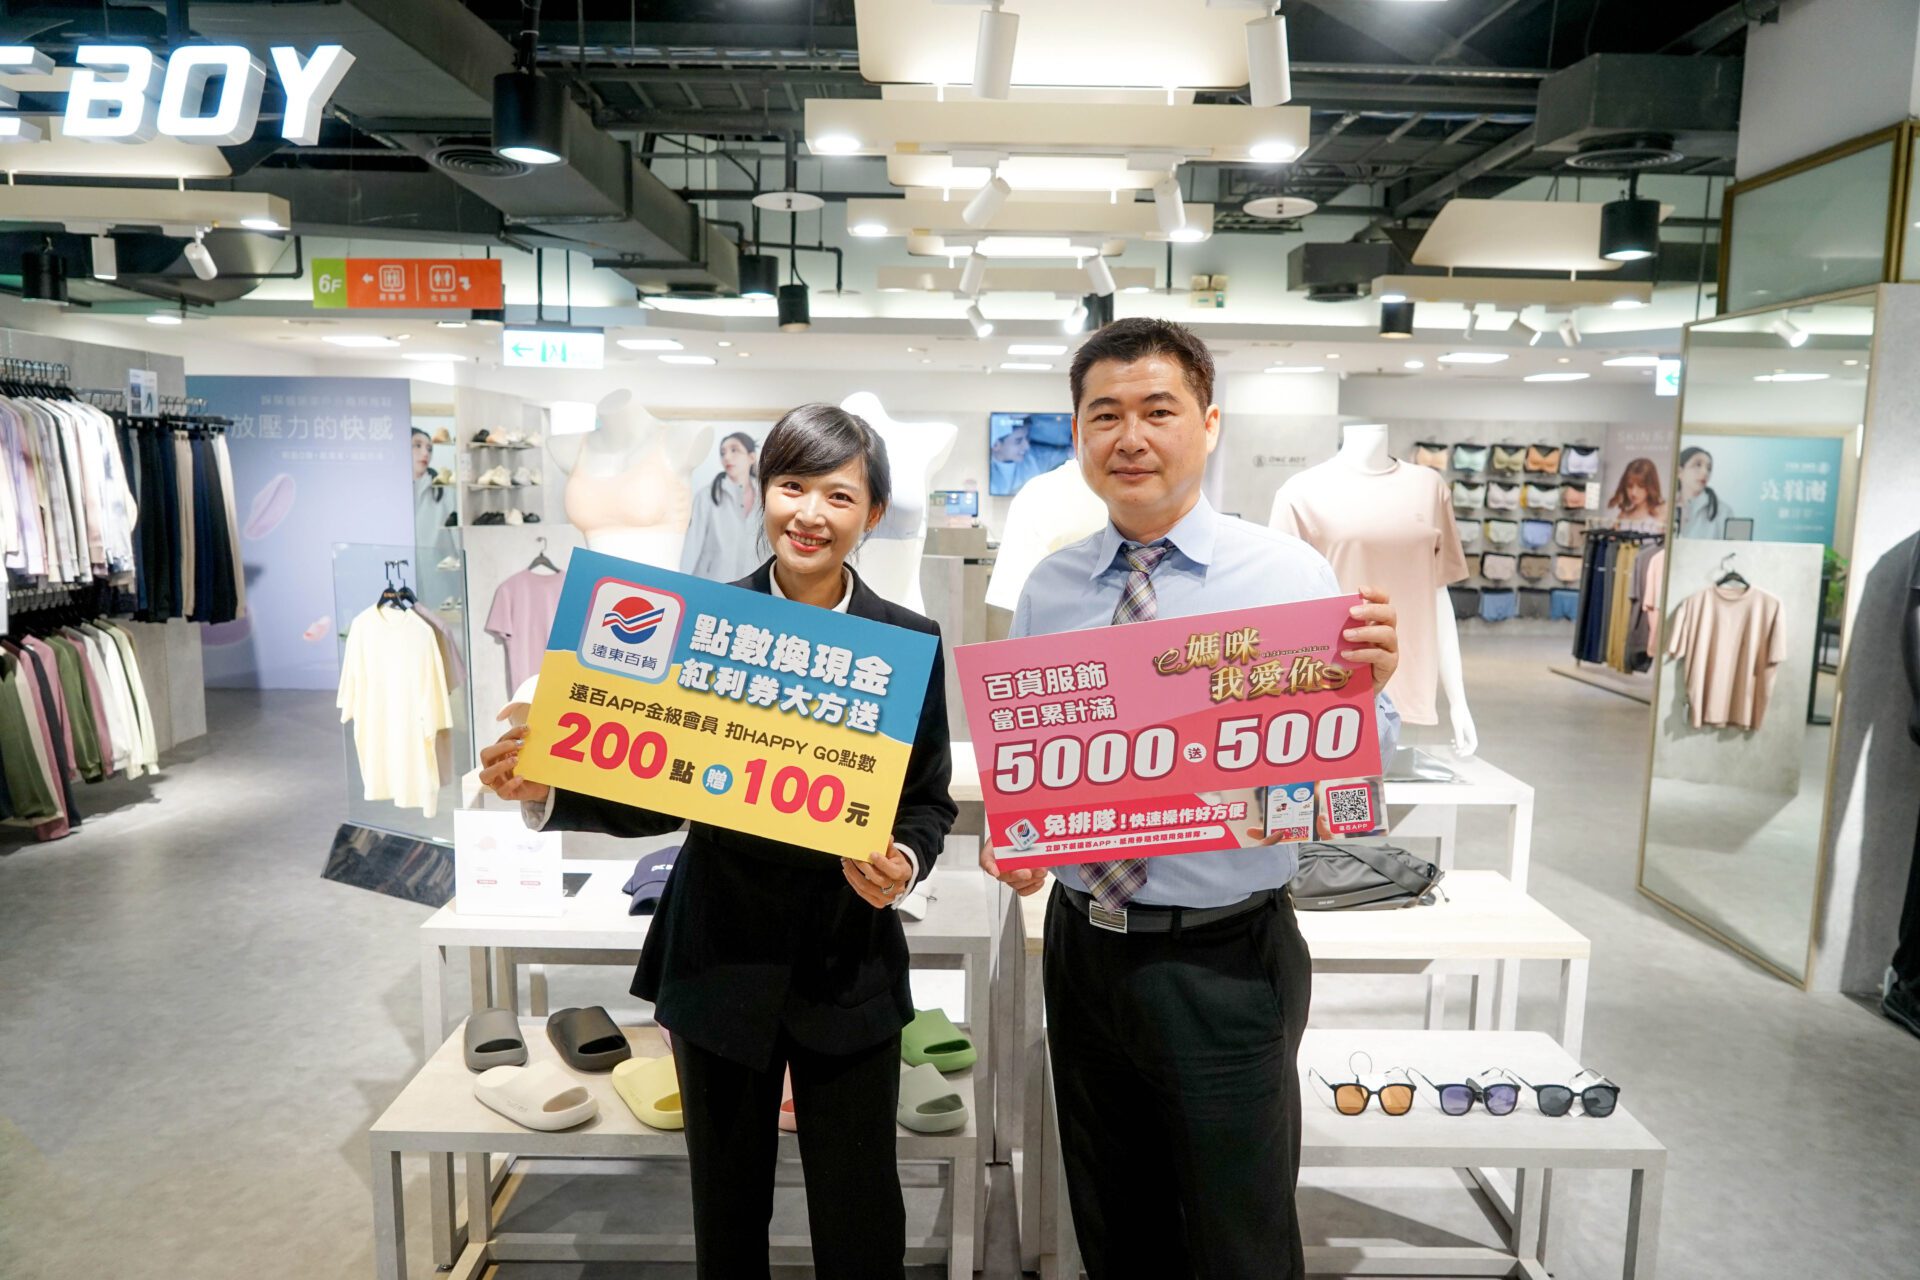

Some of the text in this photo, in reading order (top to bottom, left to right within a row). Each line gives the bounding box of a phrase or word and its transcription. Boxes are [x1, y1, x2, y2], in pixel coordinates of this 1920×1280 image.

[62, 44, 354, 146] BOY
[318, 273, 342, 295] 6F
[591, 643, 658, 671] 遠東百貨
[689, 613, 893, 697] 點數換現金
[983, 661, 1108, 700] 百貨服飾
[568, 682, 877, 775] 遠百APP金級會員 扣HAPPY GO點數
[677, 657, 881, 734] 紅利券大方送
[990, 696, 1116, 732] 當日累計滿
[993, 723, 1179, 795] 5000
[1213, 703, 1365, 773] 500
